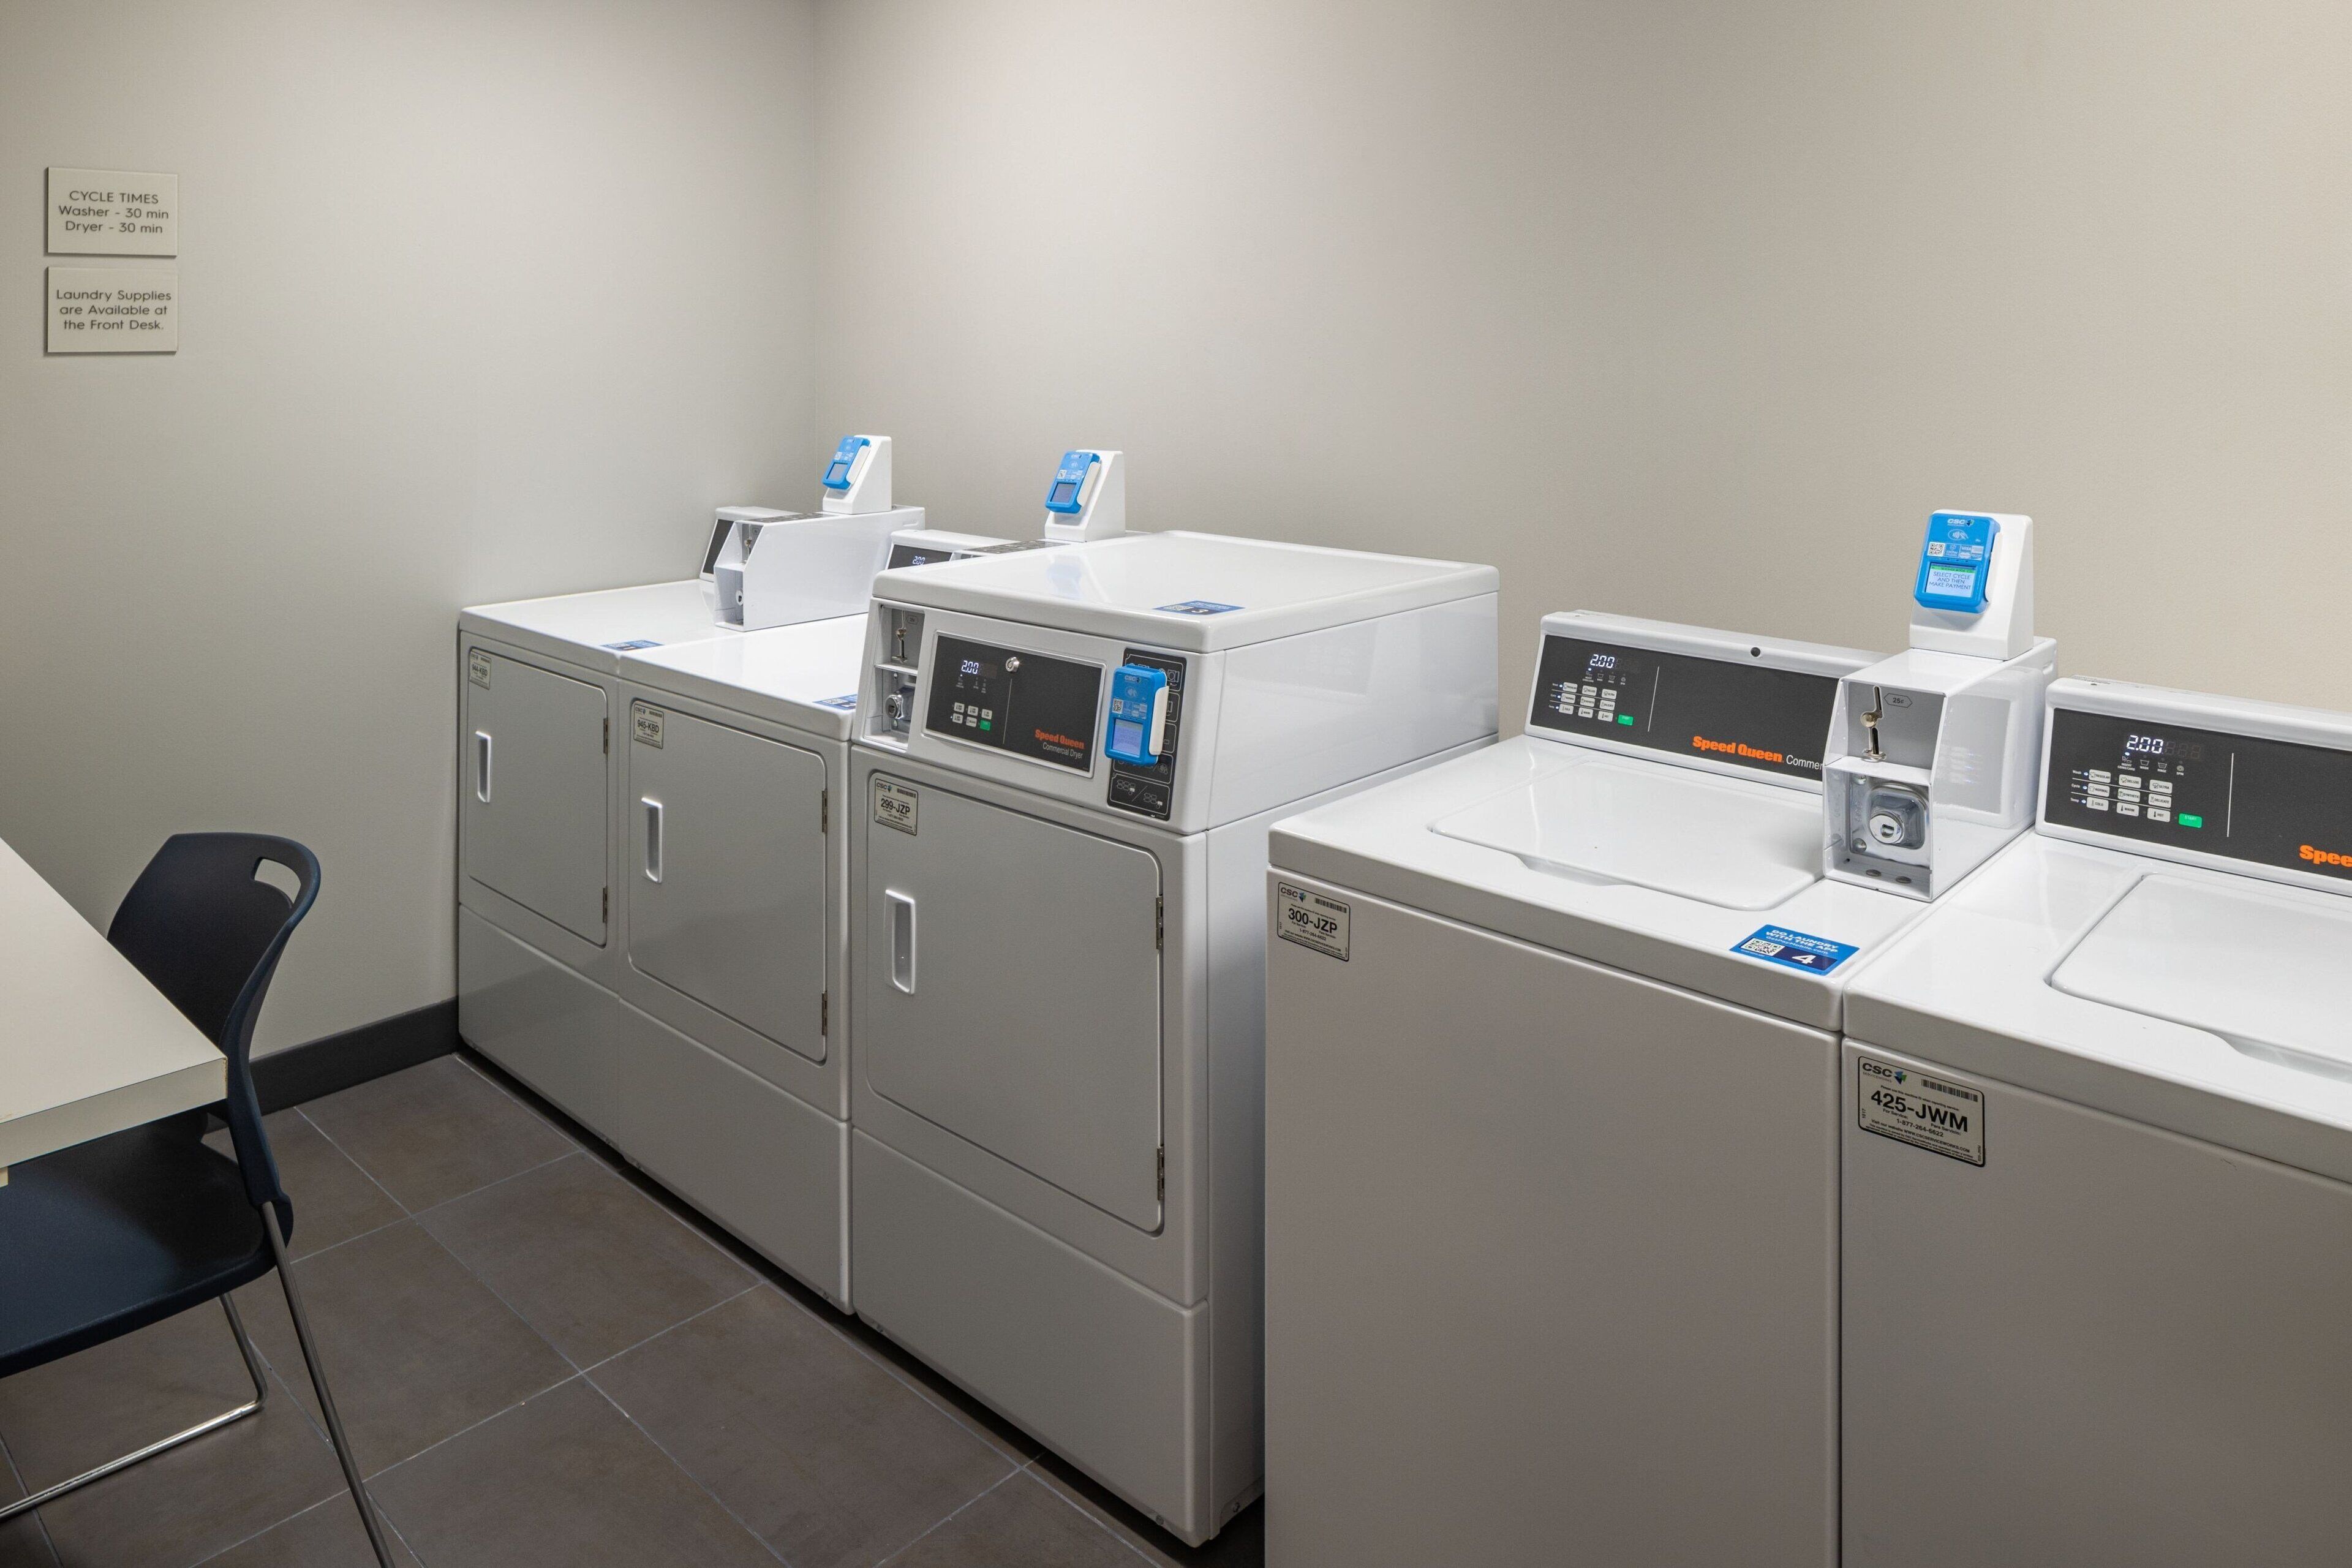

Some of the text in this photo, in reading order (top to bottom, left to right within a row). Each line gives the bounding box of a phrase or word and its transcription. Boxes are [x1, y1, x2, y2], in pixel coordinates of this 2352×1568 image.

[69, 190, 159, 204] CYCLE TIMES
[59, 205, 110, 217] Washer
[125, 208, 141, 219] 30
[146, 209, 168, 219] min
[66, 221, 103, 234] Dryer
[119, 222, 135, 233] 30
[140, 223, 163, 233] min
[56, 289, 172, 302] Laundry Supplies
[60, 305, 168, 315] are Available at
[63, 320, 164, 330] the Front Desk.
[961, 660, 979, 674] 2.00
[1590, 654, 1615, 668] 2.00
[1035, 729, 1085, 749] Speed Queen
[2127, 734, 2164, 754] 2.00
[1042, 742, 1083, 760] Commercial Dryer
[1692, 736, 1736, 754] Speed
[1737, 744, 1782, 763] Queen
[881, 798, 910, 815] 299-JZP
[1281, 887, 1298, 898] CSC
[1288, 908, 1337, 933] 300-JZP
[1766, 932, 1794, 941] WITH
[1789, 934, 1839, 949] LAUNDRY
[1792, 955, 1817, 965] 4
[1862, 1063, 1893, 1077] CSC
[1871, 1090, 1968, 1133] 425-JWM
[1897, 1118, 1944, 1138] 1-877-264-6622
